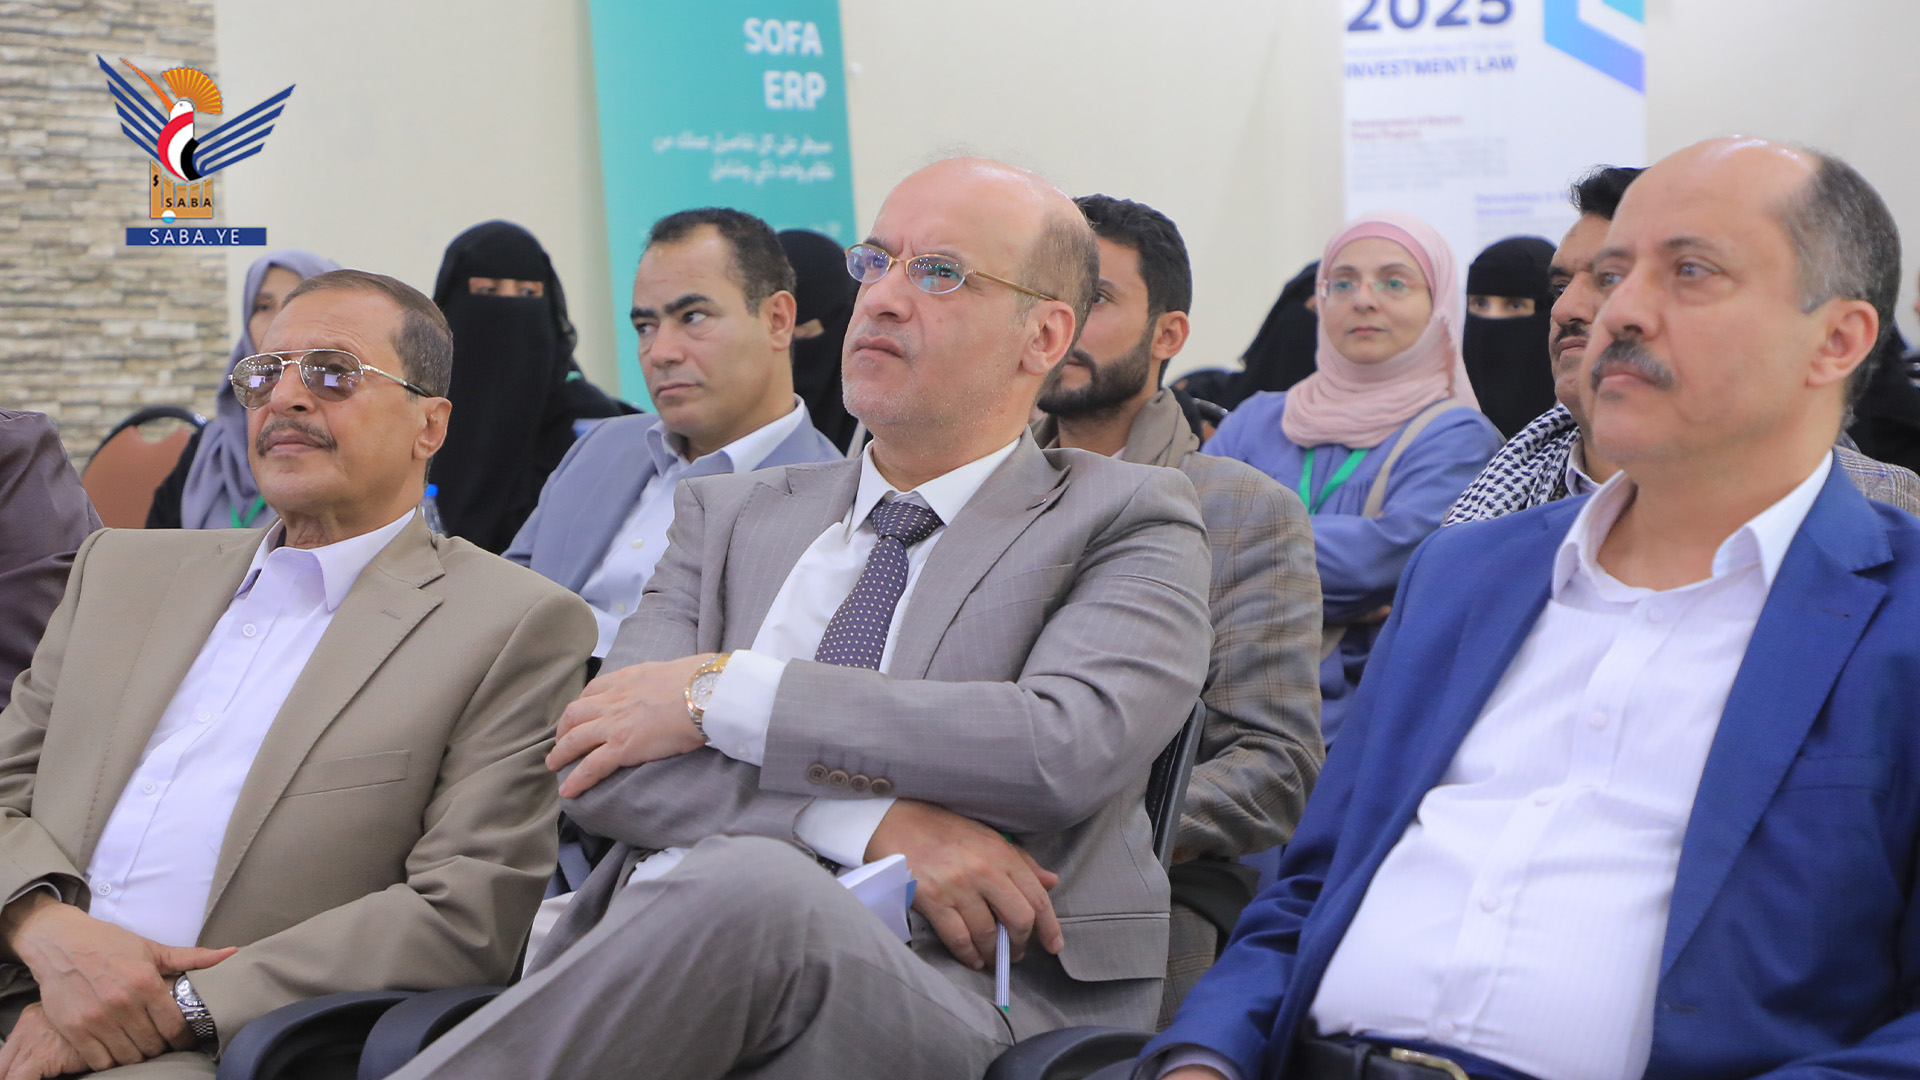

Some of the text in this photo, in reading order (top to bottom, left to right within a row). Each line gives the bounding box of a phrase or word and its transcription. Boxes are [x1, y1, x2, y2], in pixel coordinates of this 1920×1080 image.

[1347, 0, 1514, 32] 2025
[744, 17, 823, 56] SOFA
[1346, 55, 1518, 78] INVESTMENT LAW
[763, 70, 826, 110] ERP
